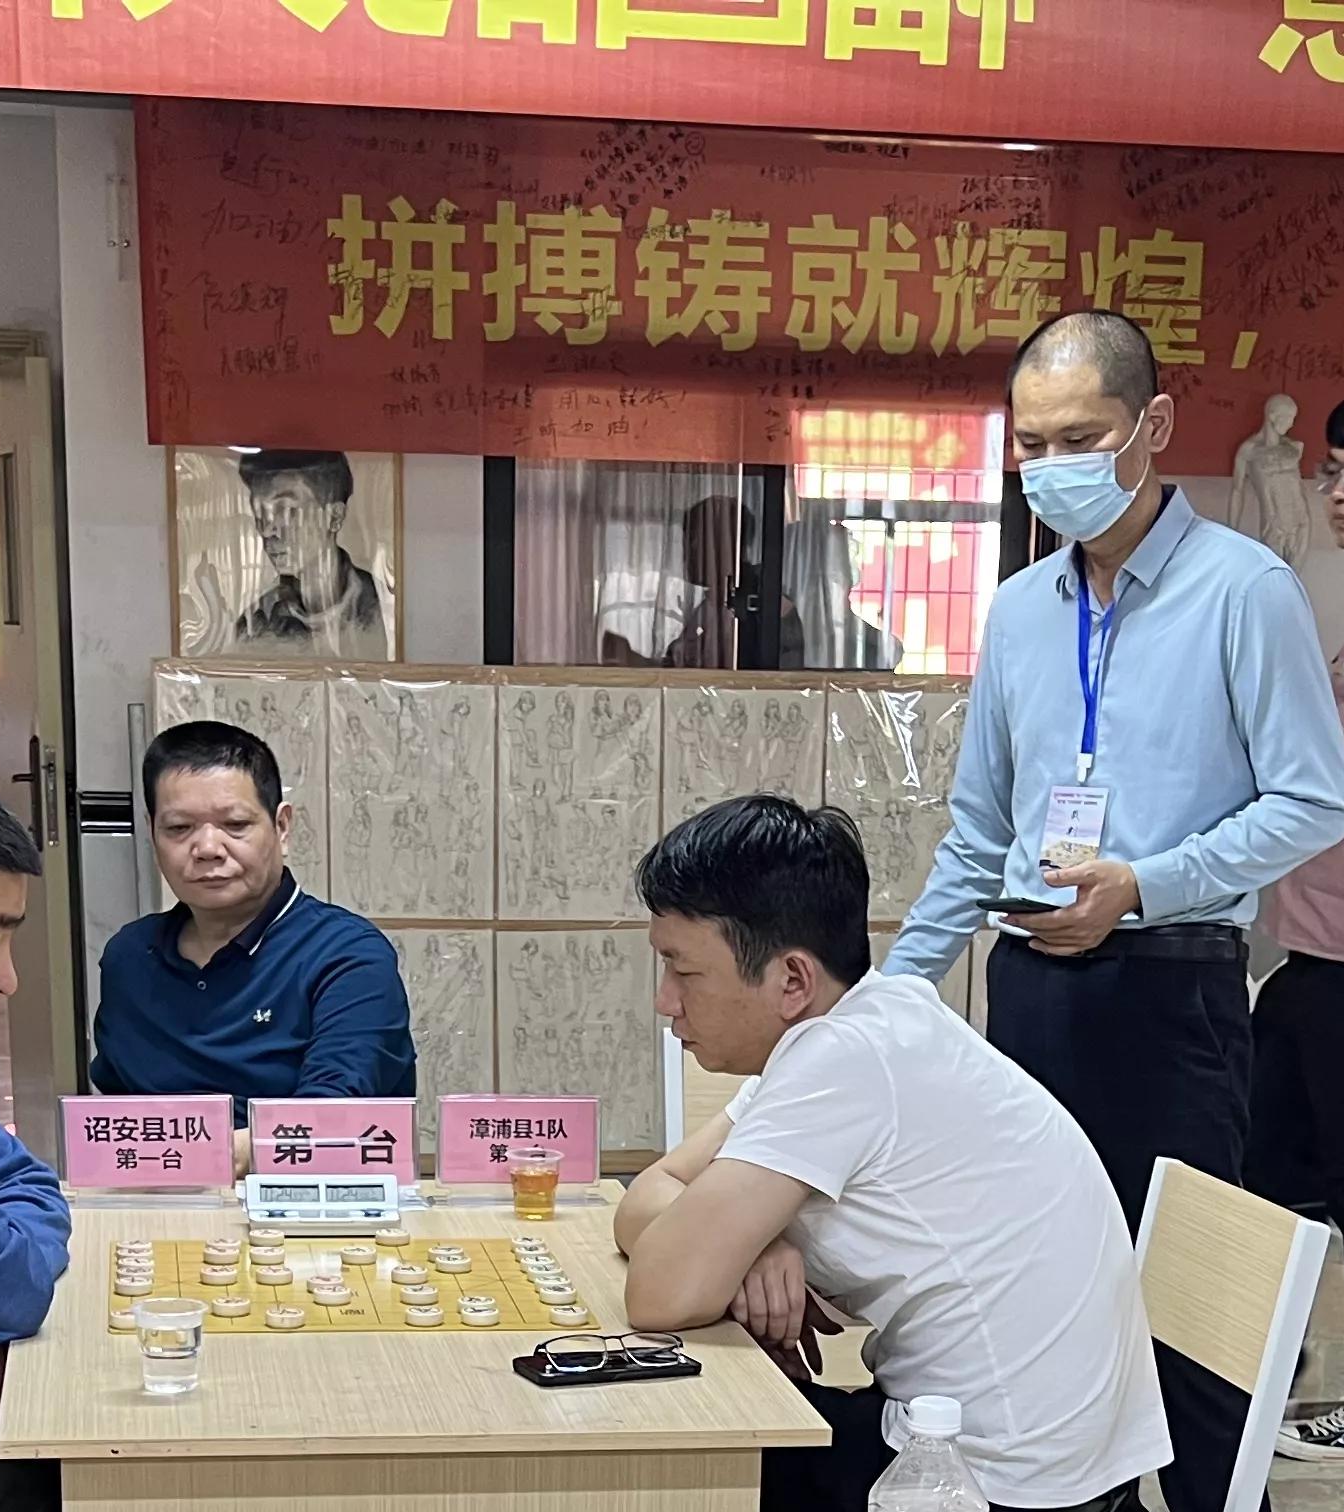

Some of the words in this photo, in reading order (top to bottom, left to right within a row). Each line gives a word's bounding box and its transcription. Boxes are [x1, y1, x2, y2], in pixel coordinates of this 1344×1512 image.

[84, 1116, 212, 1143] 诏安县1队
[469, 1118, 568, 1139] 漳浦县1队
[271, 1123, 398, 1165] 第一台
[489, 1144, 547, 1163] 第台
[116, 1148, 183, 1169] 第一台
